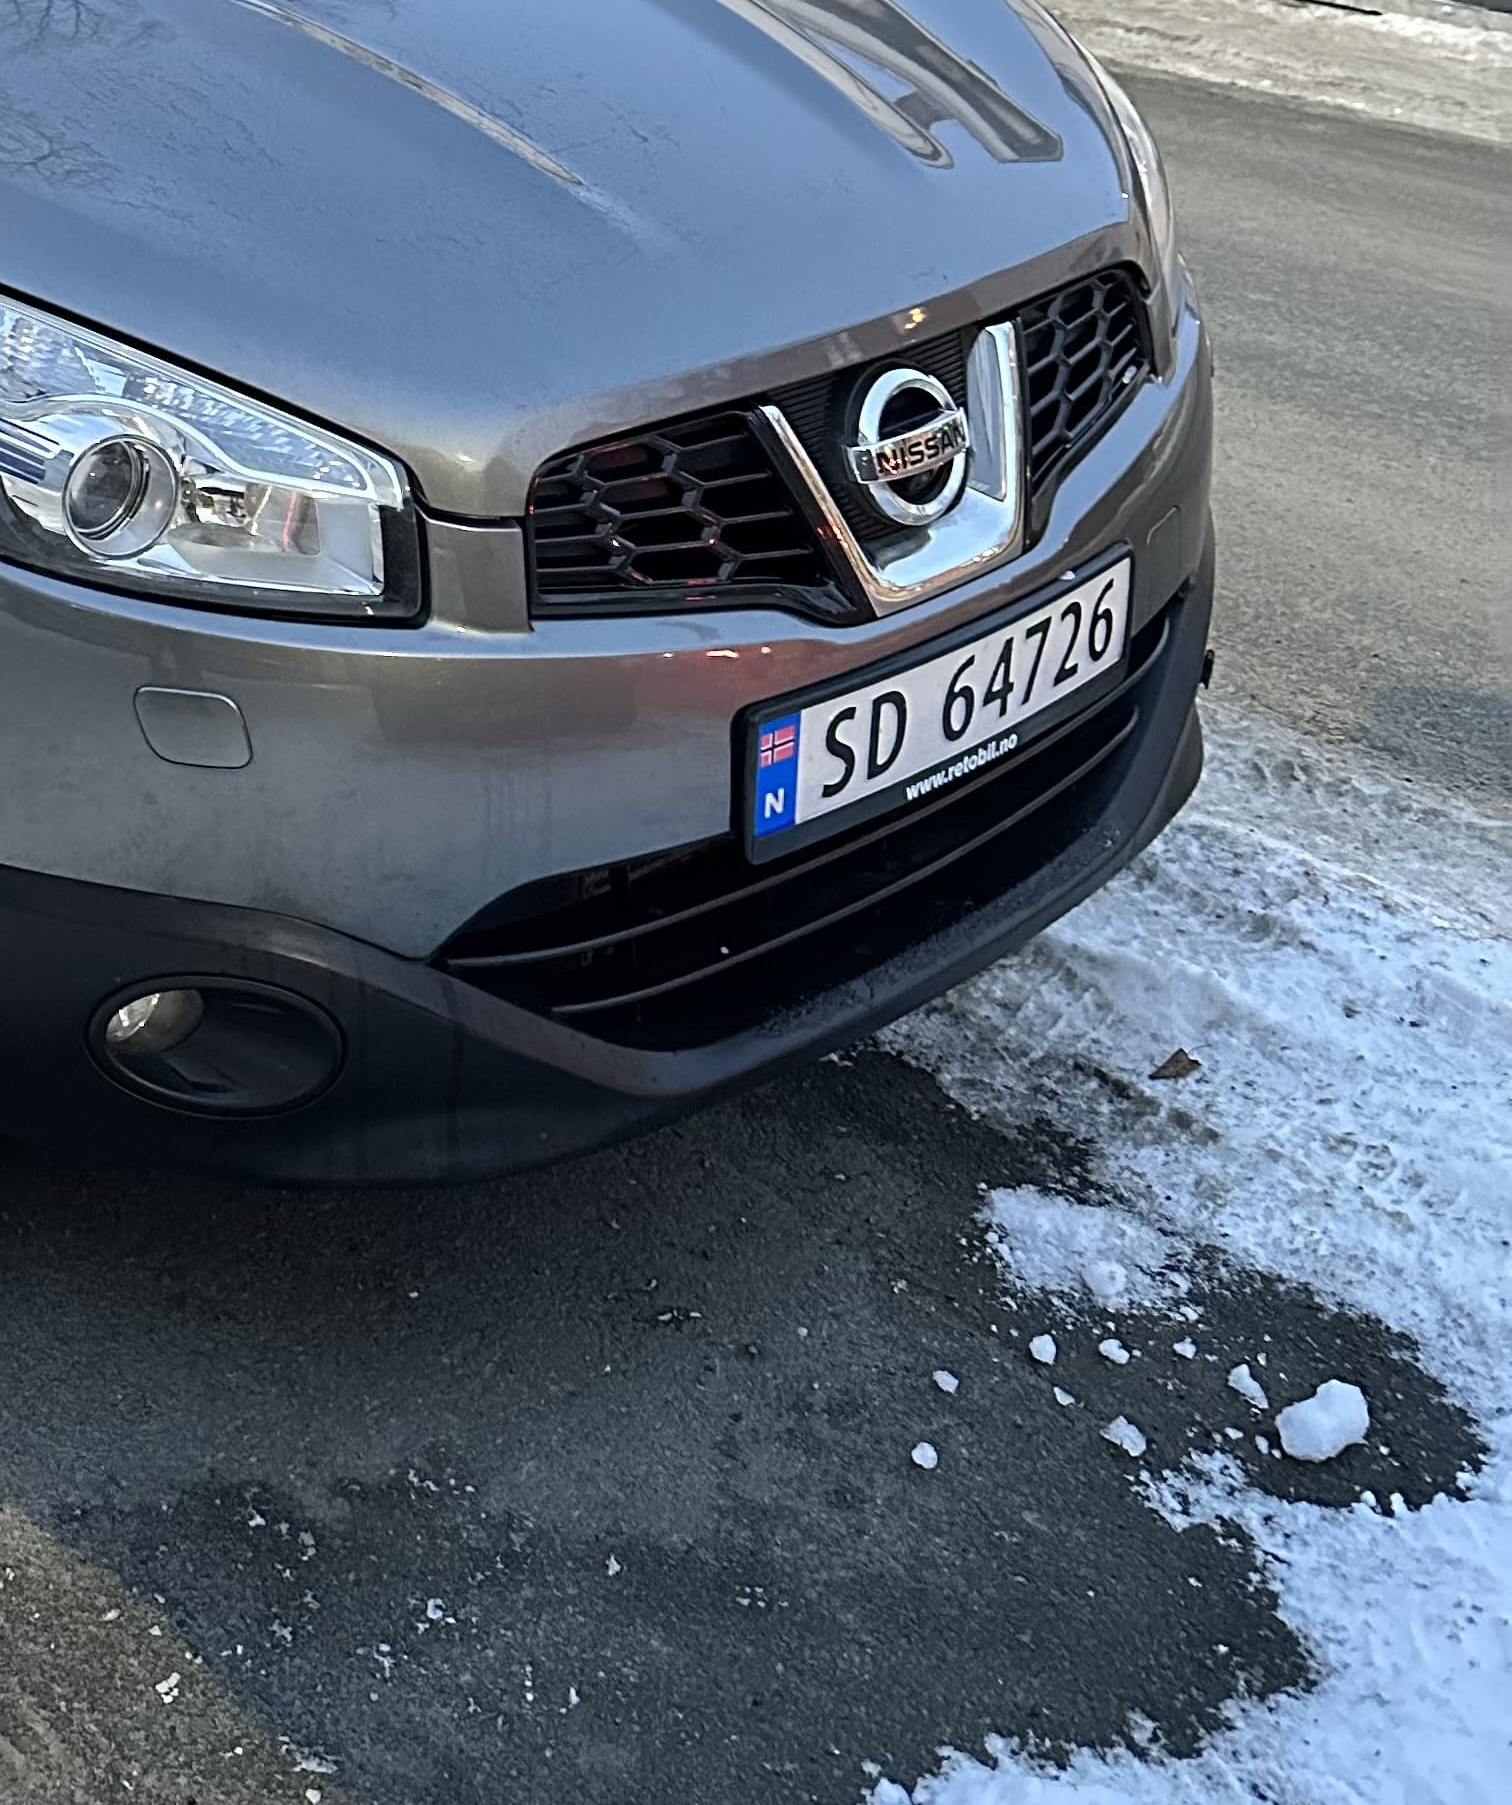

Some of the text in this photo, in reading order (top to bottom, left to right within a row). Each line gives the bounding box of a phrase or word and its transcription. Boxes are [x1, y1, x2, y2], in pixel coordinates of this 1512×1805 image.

[876, 420, 967, 474] NISSAN
[822, 580, 1114, 797] SD 64726
[906, 733, 1018, 801] www.retobil.no
[764, 787, 785, 819] N
